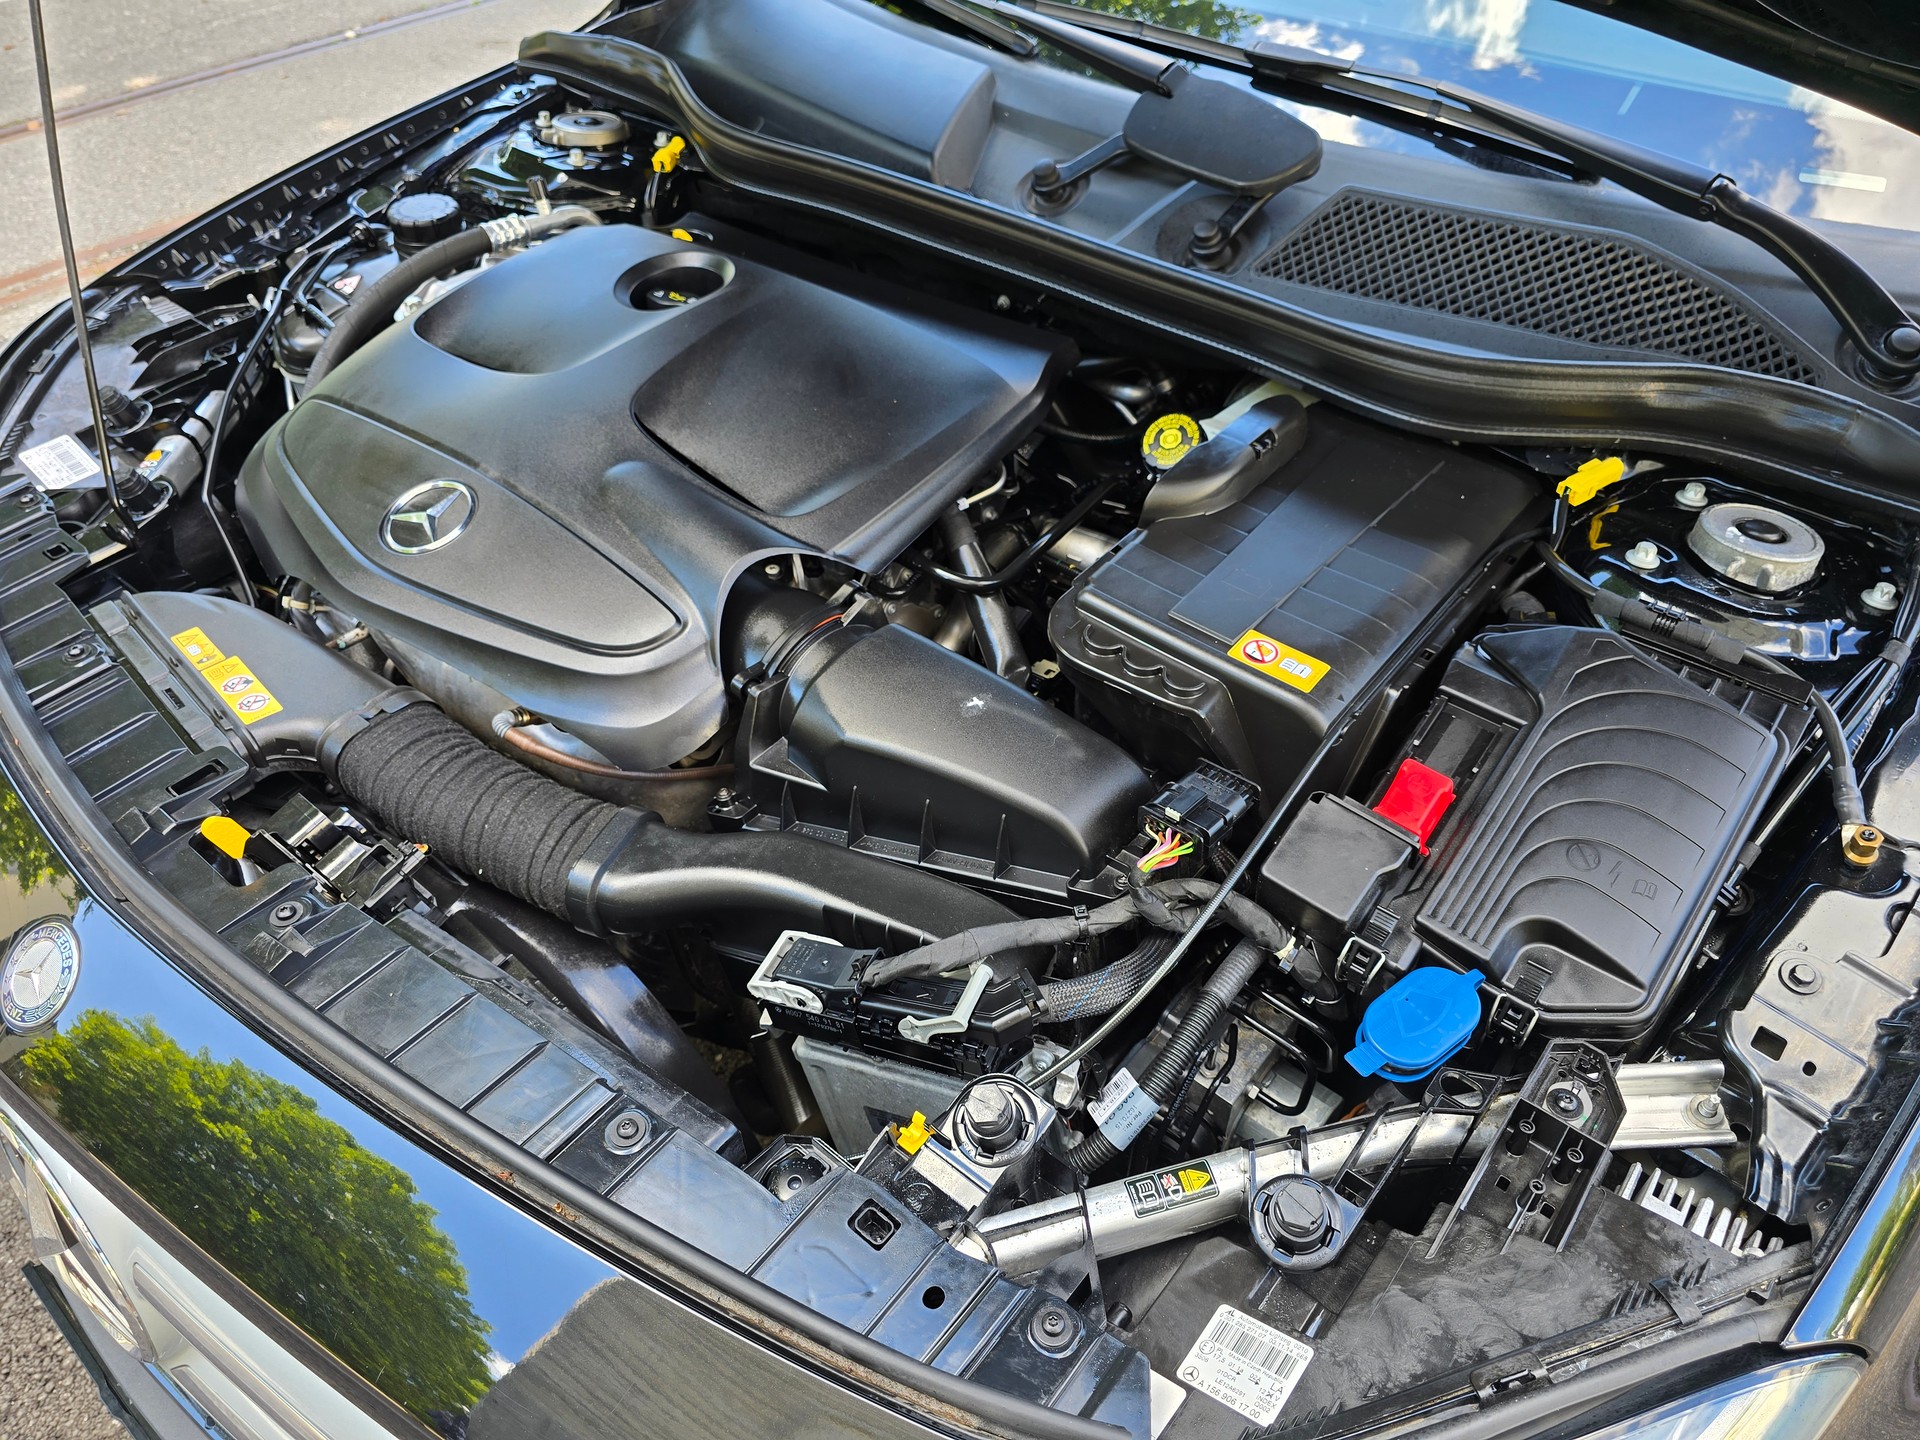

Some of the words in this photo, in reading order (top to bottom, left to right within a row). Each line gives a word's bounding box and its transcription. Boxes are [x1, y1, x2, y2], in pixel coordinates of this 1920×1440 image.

[38, 927, 73, 968] MERCEDES
[3, 996, 25, 1022] BENZ
[1237, 1313, 1269, 1334] Automotive
[1268, 1329, 1292, 1347] Lighting
[1292, 1342, 1309, 1354] 0210
[1257, 1331, 1267, 1340] 07
[1215, 1346, 1225, 1355] PL
[1227, 1351, 1241, 1362] Made
[1245, 1361, 1262, 1374] Czech
[1260, 1369, 1284, 1385] Republic
[1196, 1378, 1205, 1387] A
[1204, 1382, 1221, 1396] 156
[1219, 1391, 1238, 1406] 906
[1237, 1401, 1249, 1412] 17
[1247, 1407, 1262, 1419] 00
[1254, 1393, 1277, 1409] INDEX
[1269, 1381, 1285, 1395] LA
